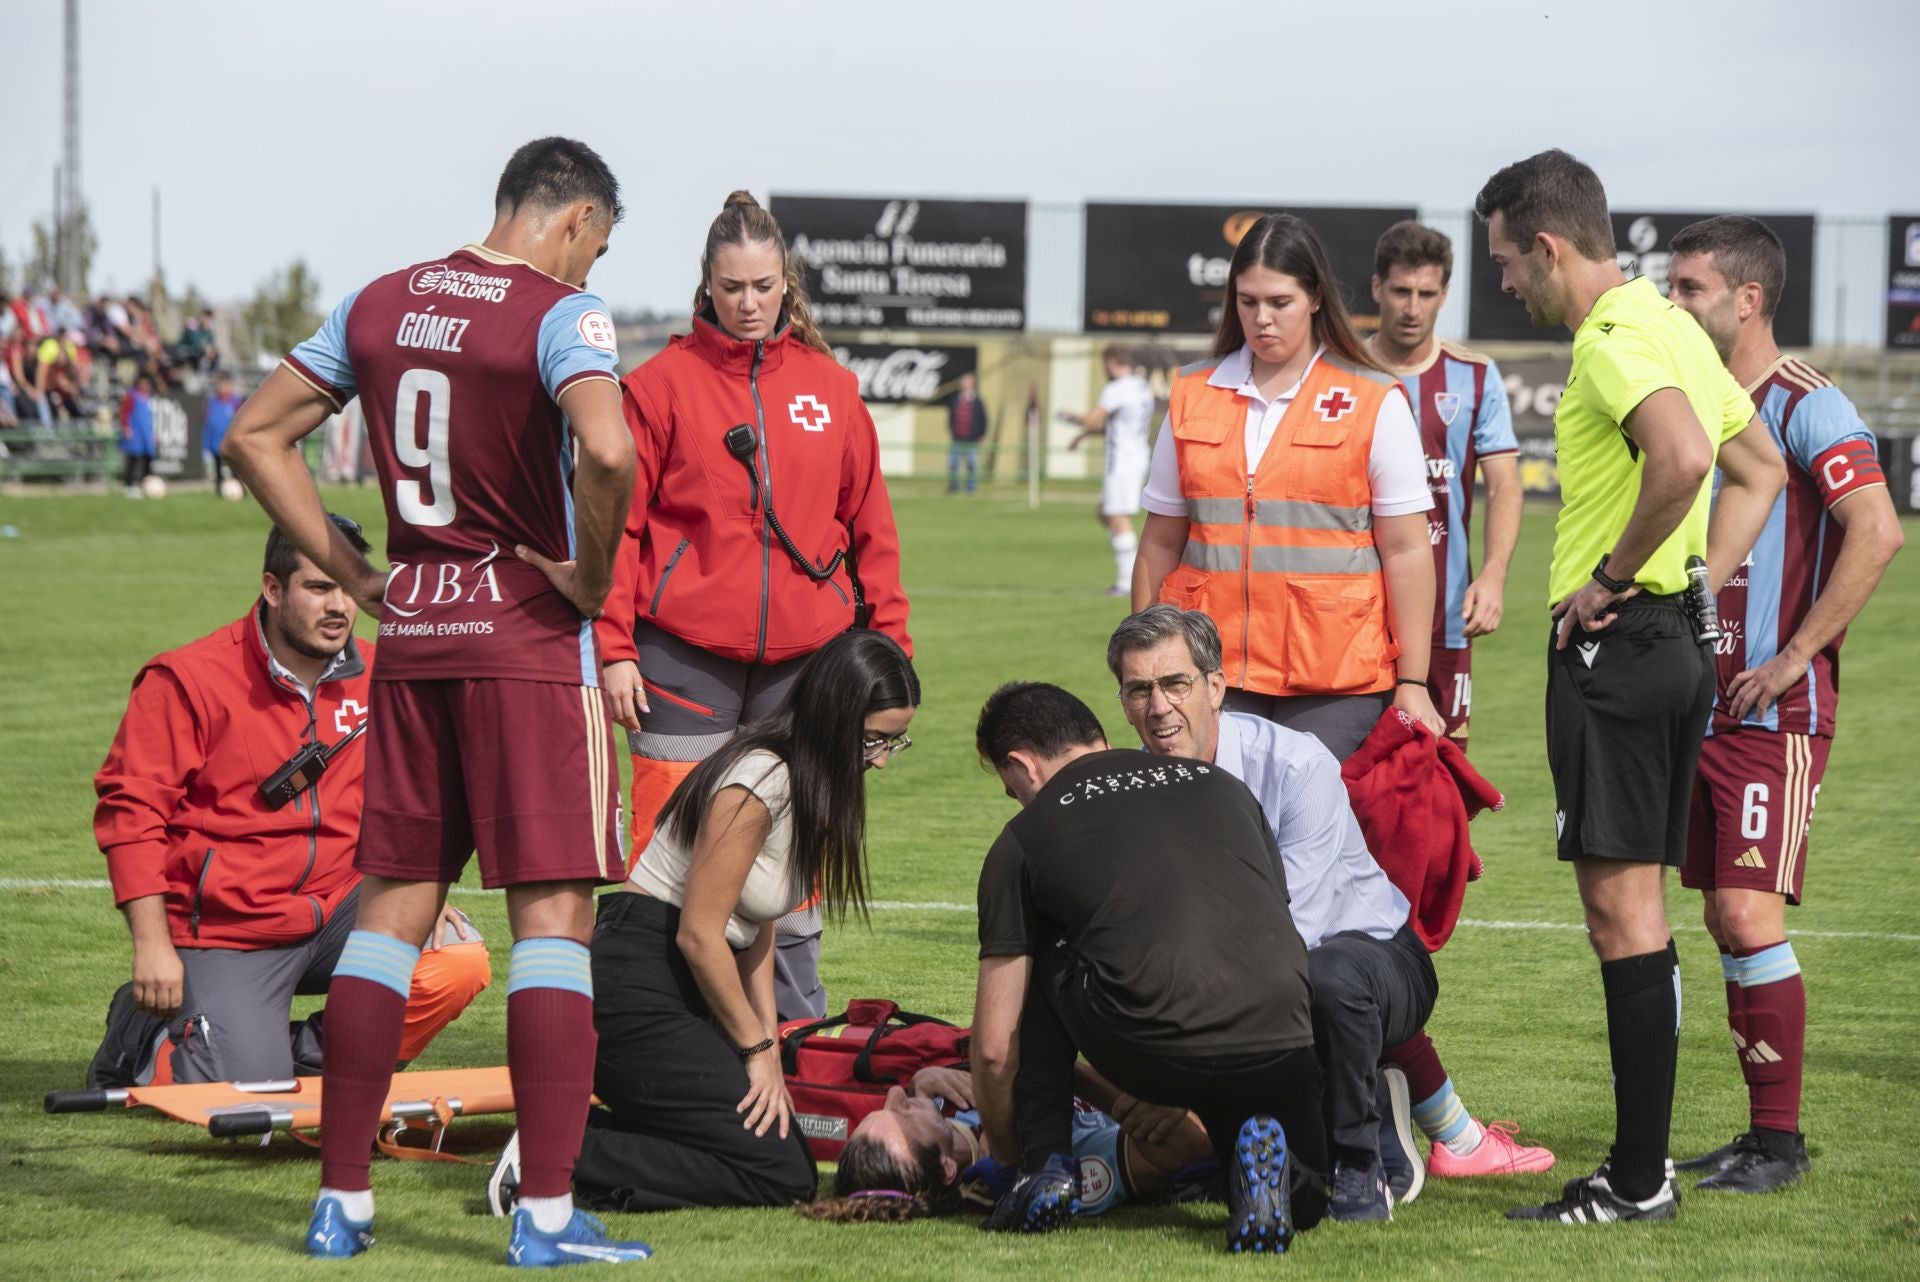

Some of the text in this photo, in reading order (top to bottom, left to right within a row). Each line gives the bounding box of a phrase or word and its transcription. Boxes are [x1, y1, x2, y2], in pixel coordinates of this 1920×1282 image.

[891, 234, 1006, 268] Funeraria
[437, 279, 506, 303] PALOMO
[445, 270, 512, 288] OCTAVIANO
[821, 265, 971, 297] Santa Teresa
[396, 305, 471, 353] GÓMEZ
[395, 368, 457, 527] 9
[1823, 455, 1854, 490] C
[397, 621, 435, 636] MARÍA
[437, 621, 494, 636] EVENTOS
[1451, 673, 1472, 717] 14
[1741, 783, 1769, 839] 6
[796, 1116, 833, 1131] strum
